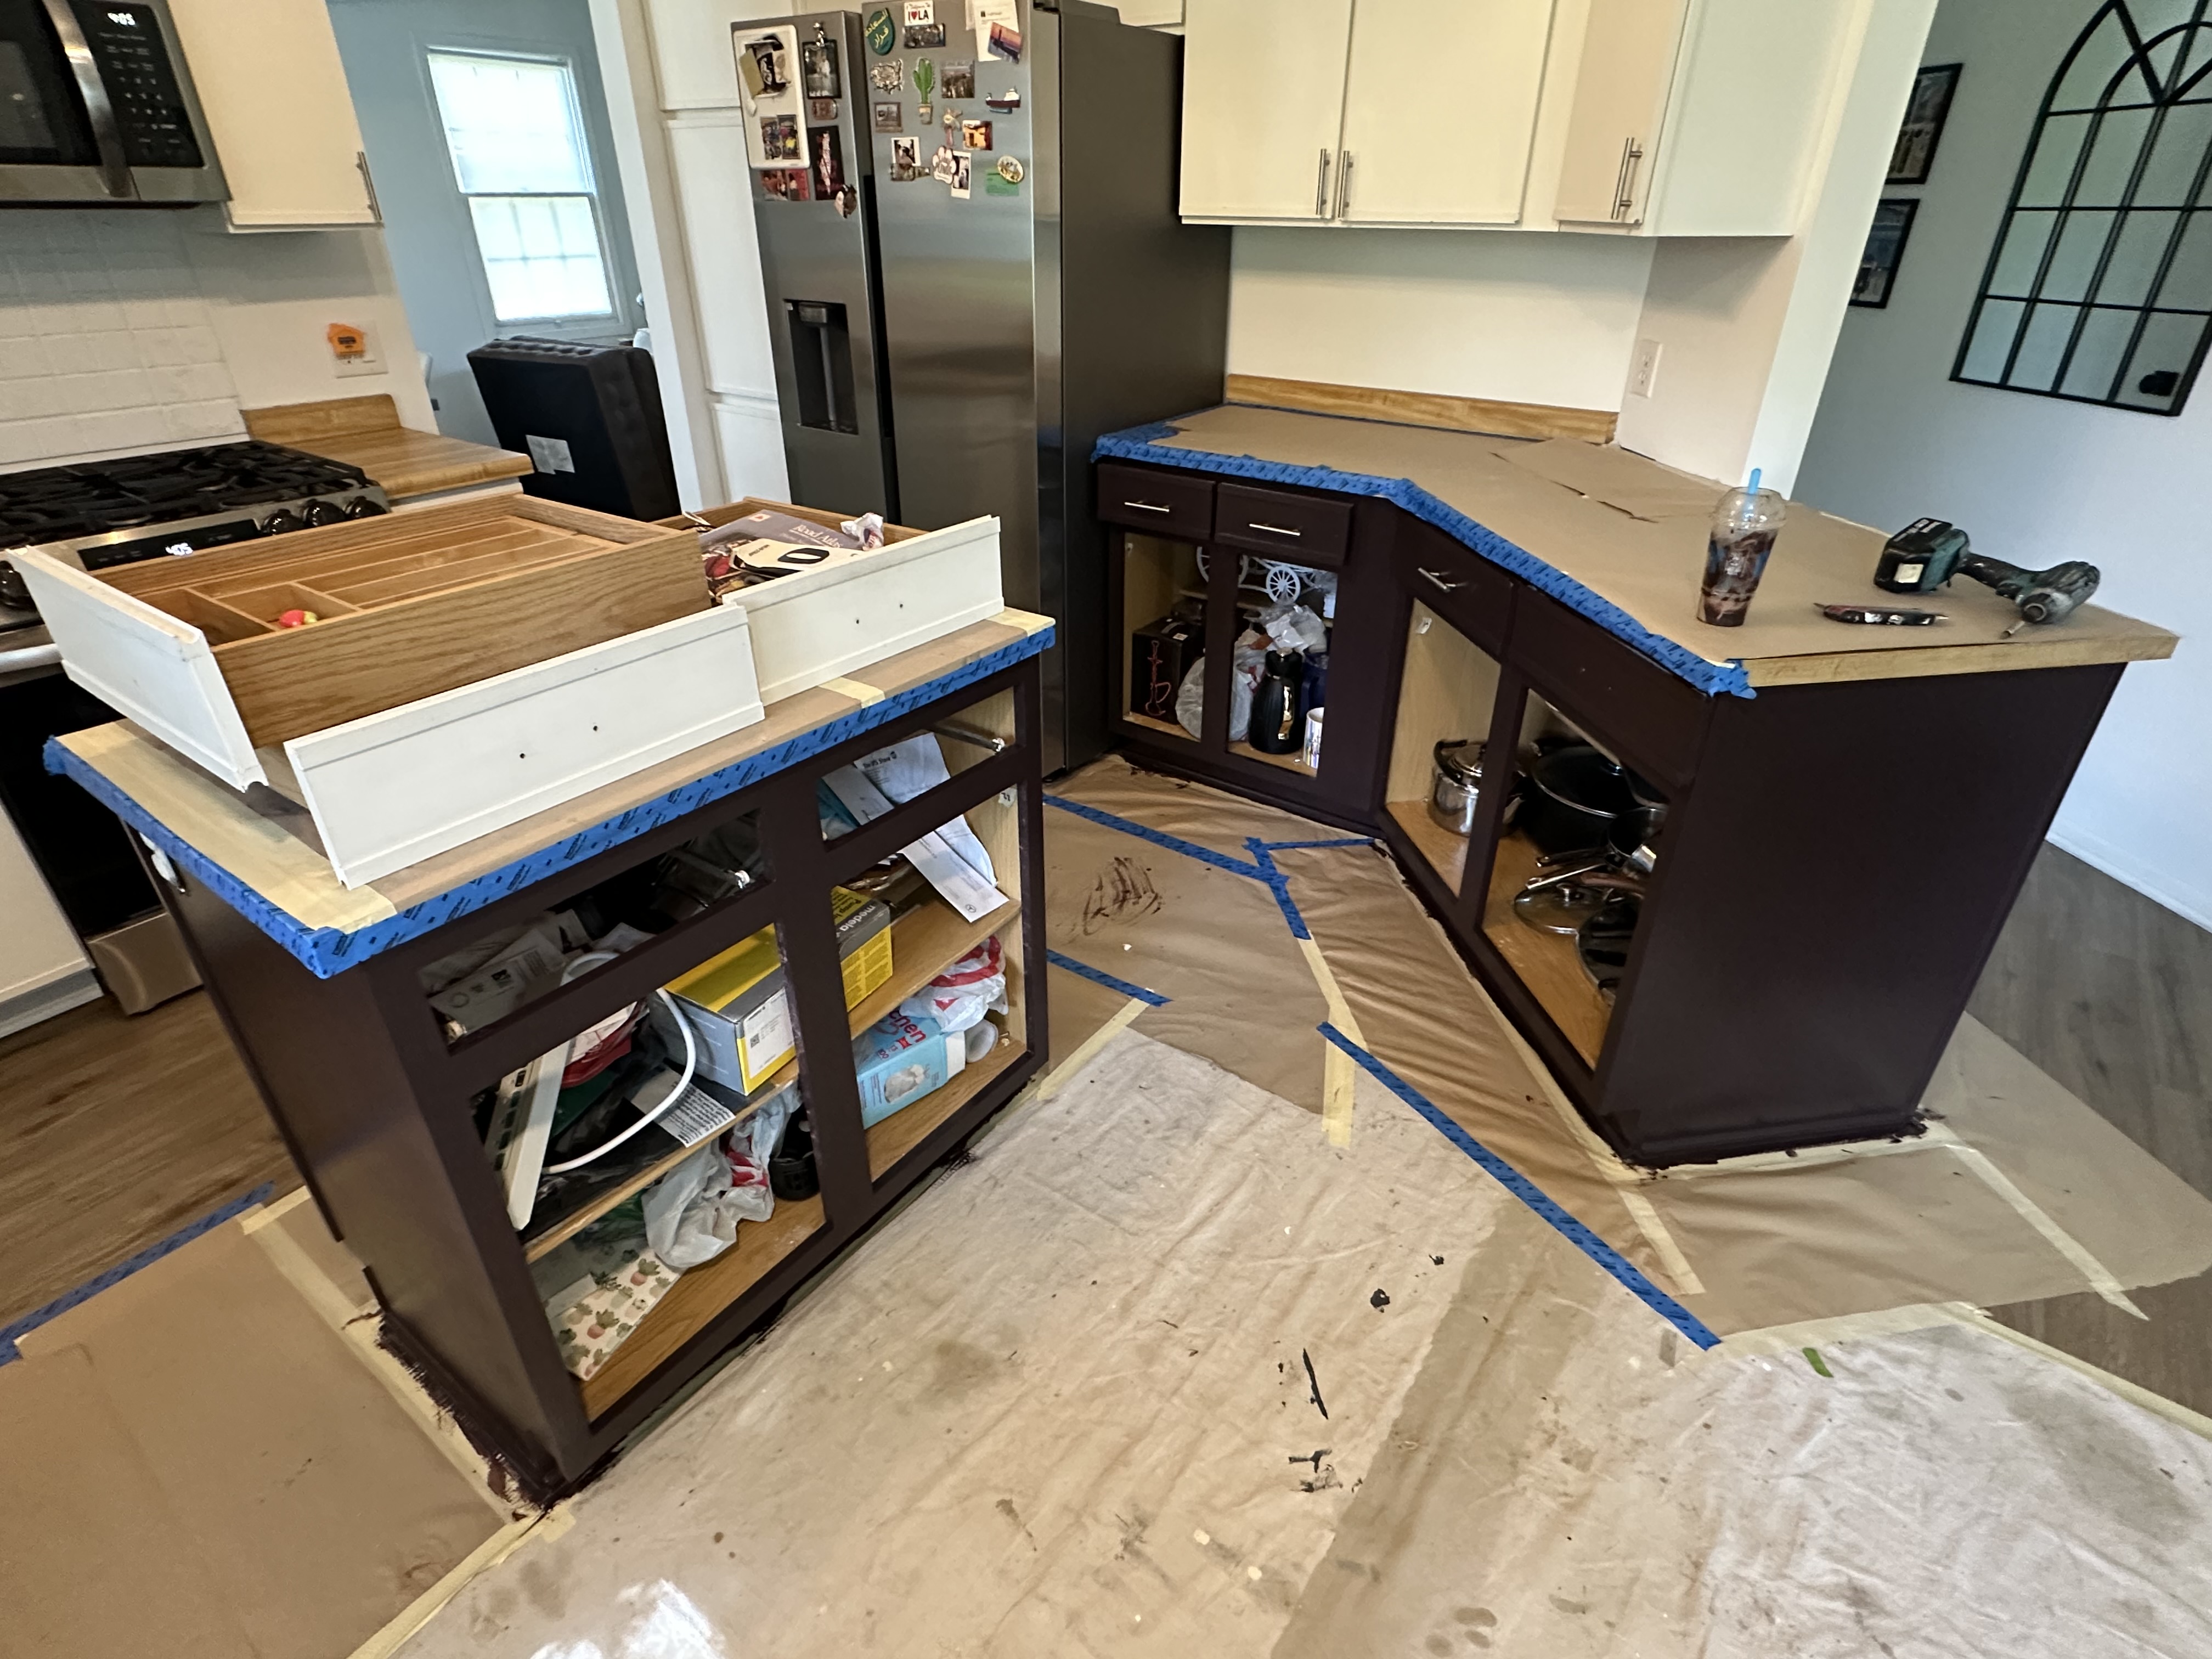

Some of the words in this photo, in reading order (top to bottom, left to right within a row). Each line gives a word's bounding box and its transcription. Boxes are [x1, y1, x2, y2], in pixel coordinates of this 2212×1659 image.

[918, 9, 929, 20] LA
[792, 524, 823, 537] Road
[839, 905, 876, 932] medela
[889, 1008, 927, 1043] chen
